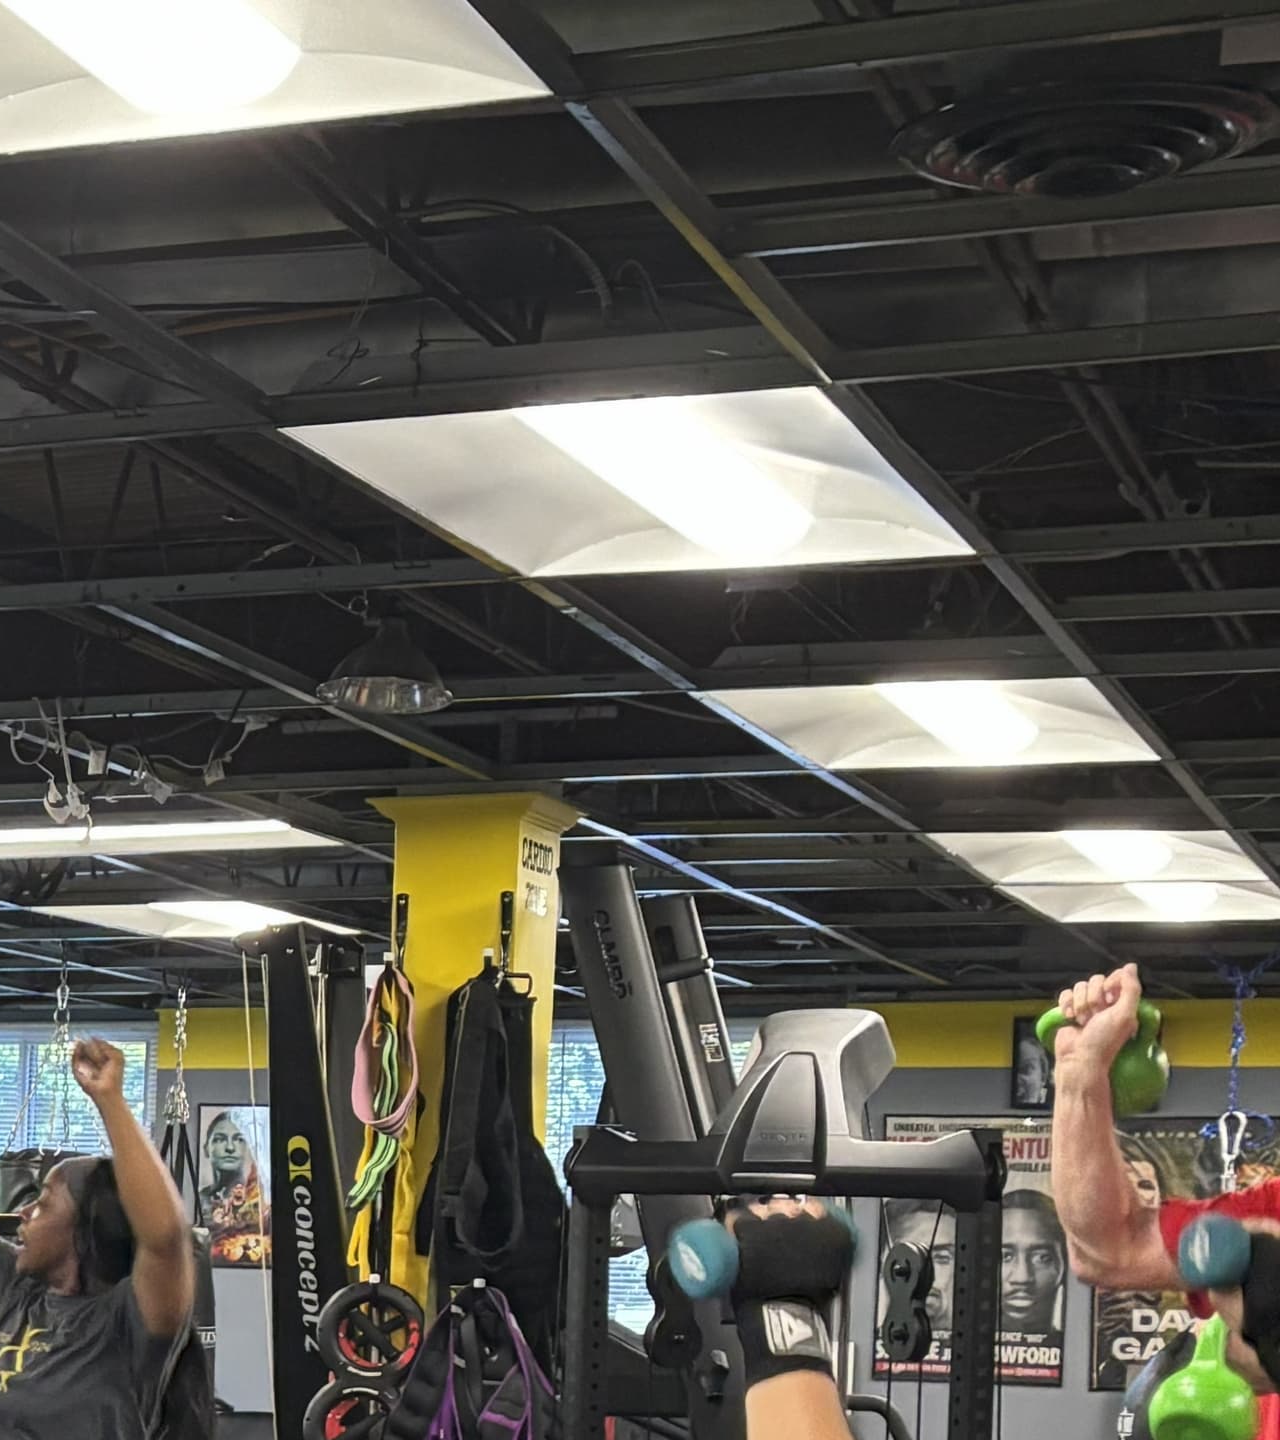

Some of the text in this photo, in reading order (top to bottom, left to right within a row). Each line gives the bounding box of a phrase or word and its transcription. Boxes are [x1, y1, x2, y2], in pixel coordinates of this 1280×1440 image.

[521, 837, 554, 875] CARDIO
[1002, 1137, 1052, 1160] ENTU
[993, 1345, 1061, 1366] WFORD
